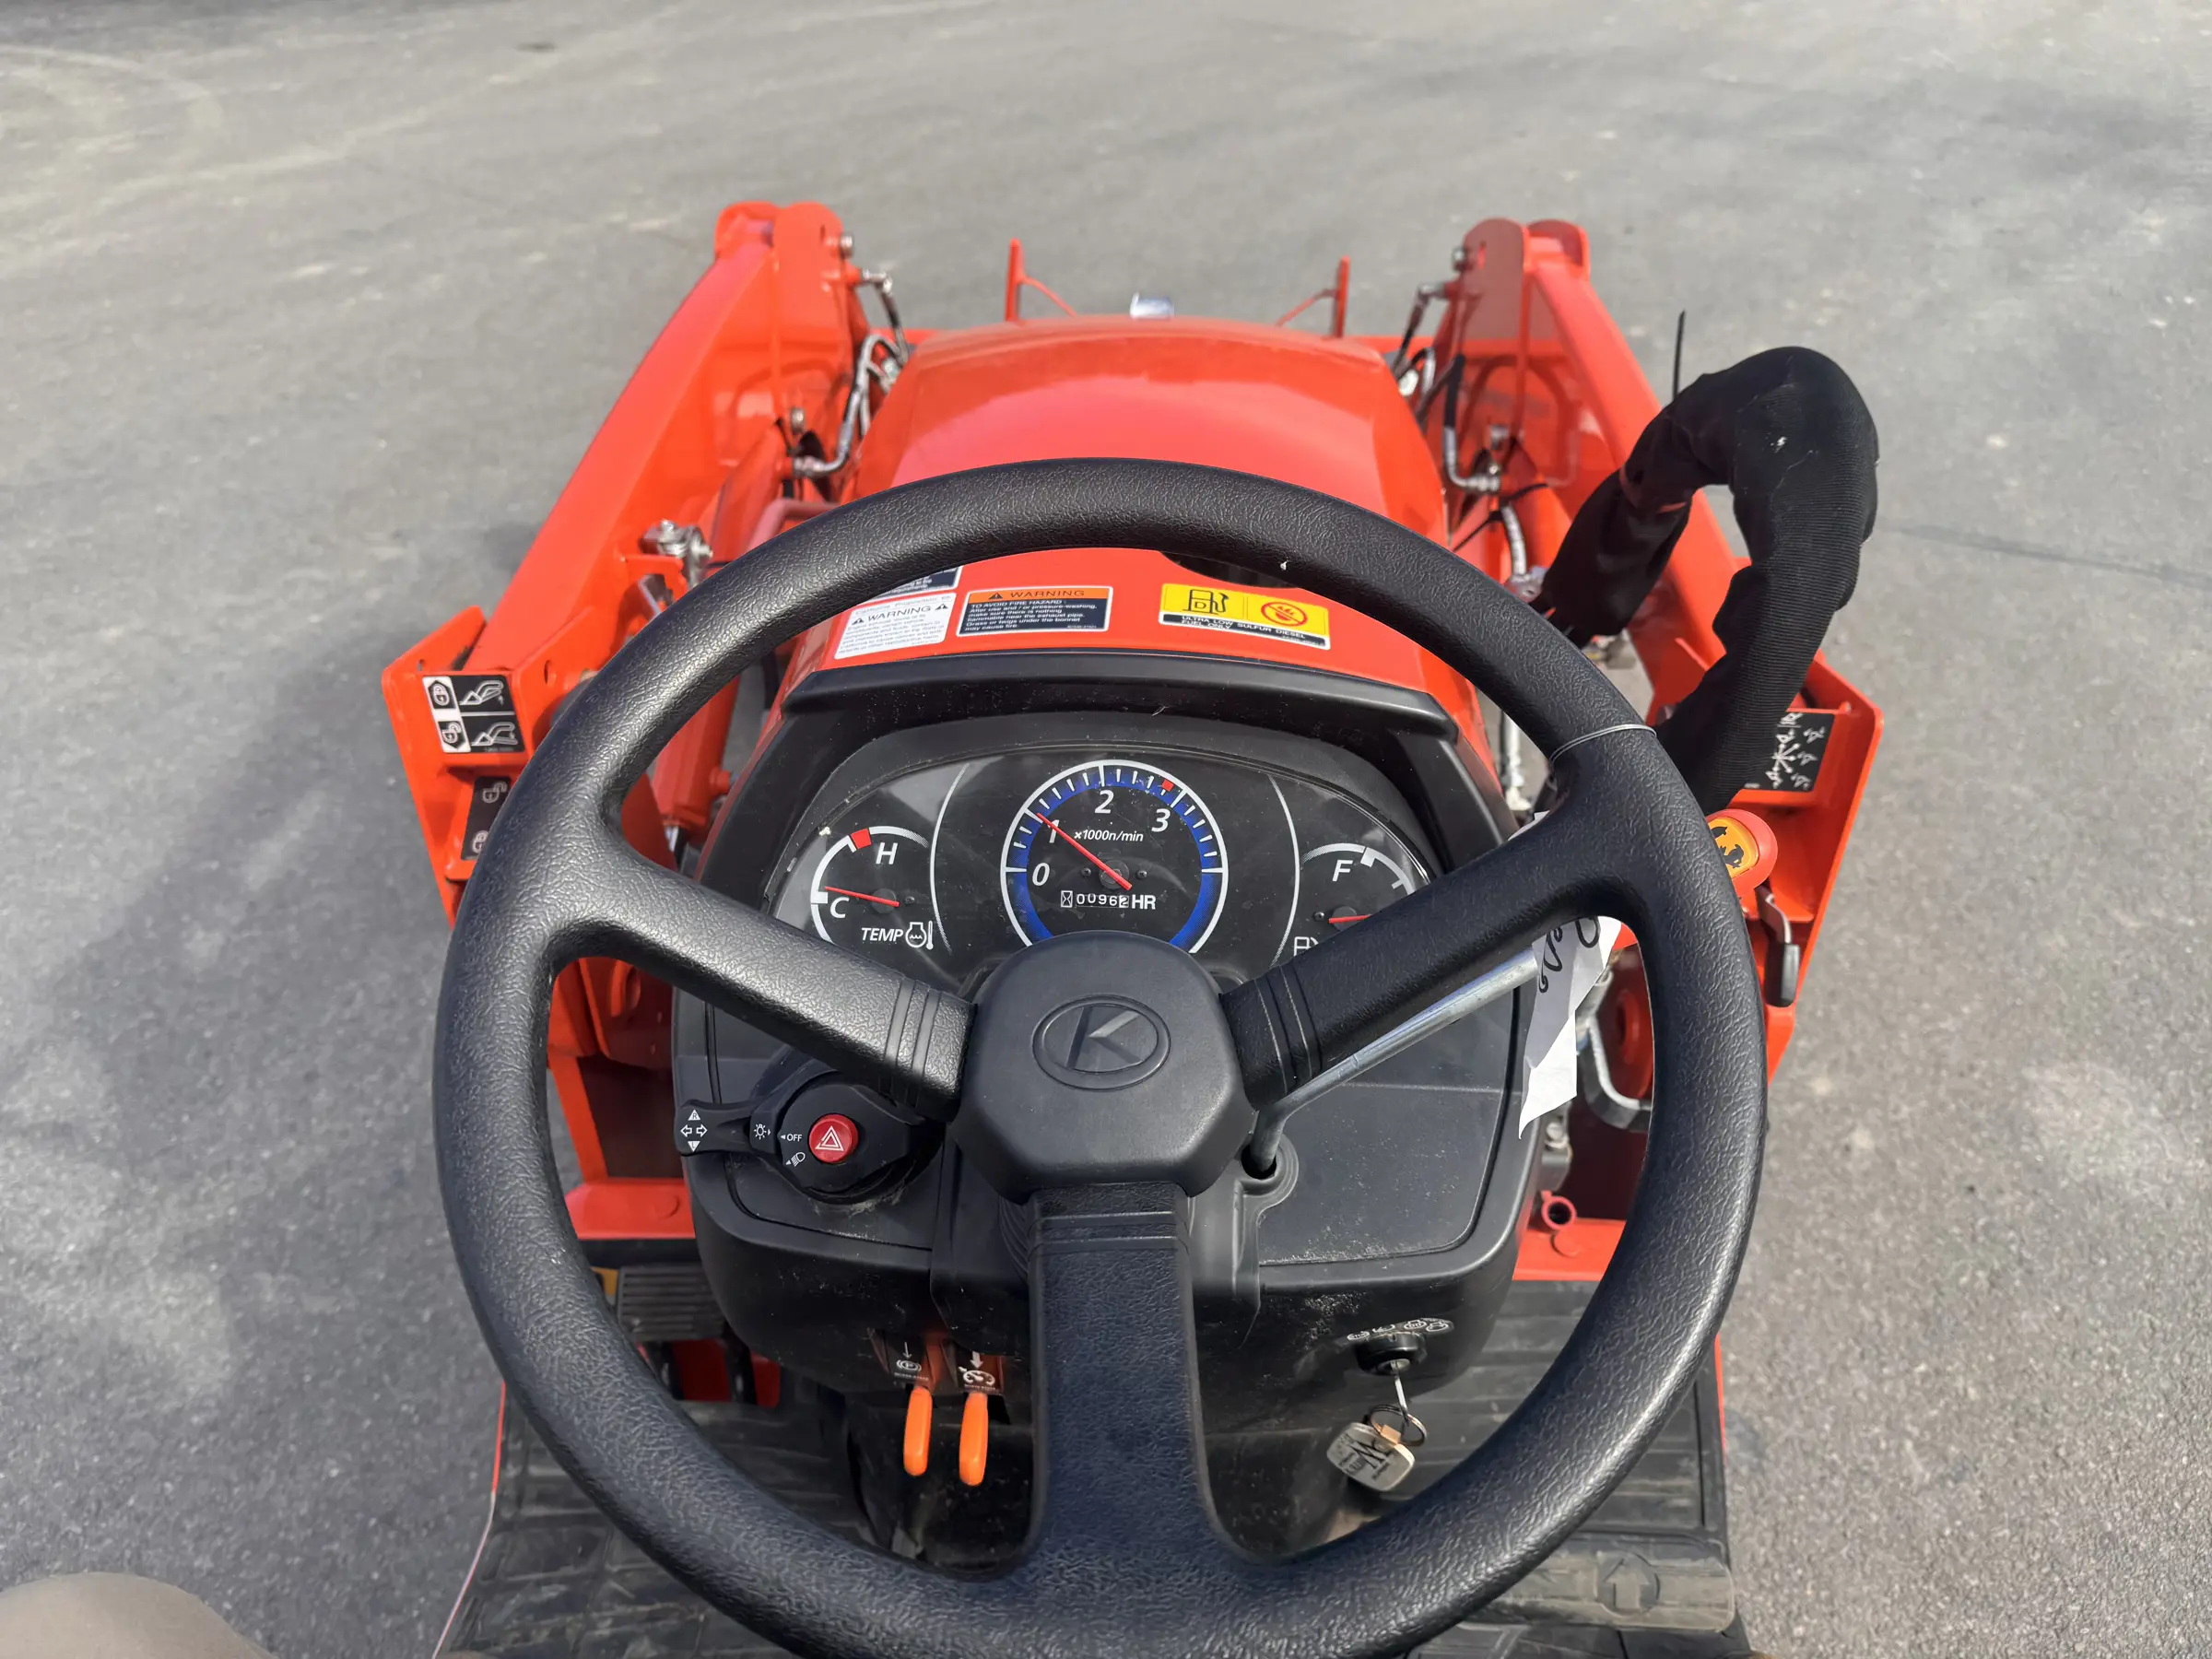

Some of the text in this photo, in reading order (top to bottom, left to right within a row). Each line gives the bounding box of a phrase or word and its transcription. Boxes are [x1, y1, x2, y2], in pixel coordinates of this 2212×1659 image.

[1010, 590, 1085, 598] WARNING
[868, 606, 931, 621] WARNING
[1237, 622, 1272, 632] SULFUR
[1276, 629, 1306, 639] DIESEL
[1095, 790, 1114, 814] 2
[1047, 819, 1060, 843] 1
[1151, 808, 1171, 832] 3
[876, 842, 898, 865] H
[1032, 863, 1051, 887] 0
[1332, 859, 1353, 882] F
[830, 897, 850, 919] C
[1131, 894, 1157, 910] HR
[861, 927, 903, 942] TEMP
[786, 1133, 803, 1142] OFF
